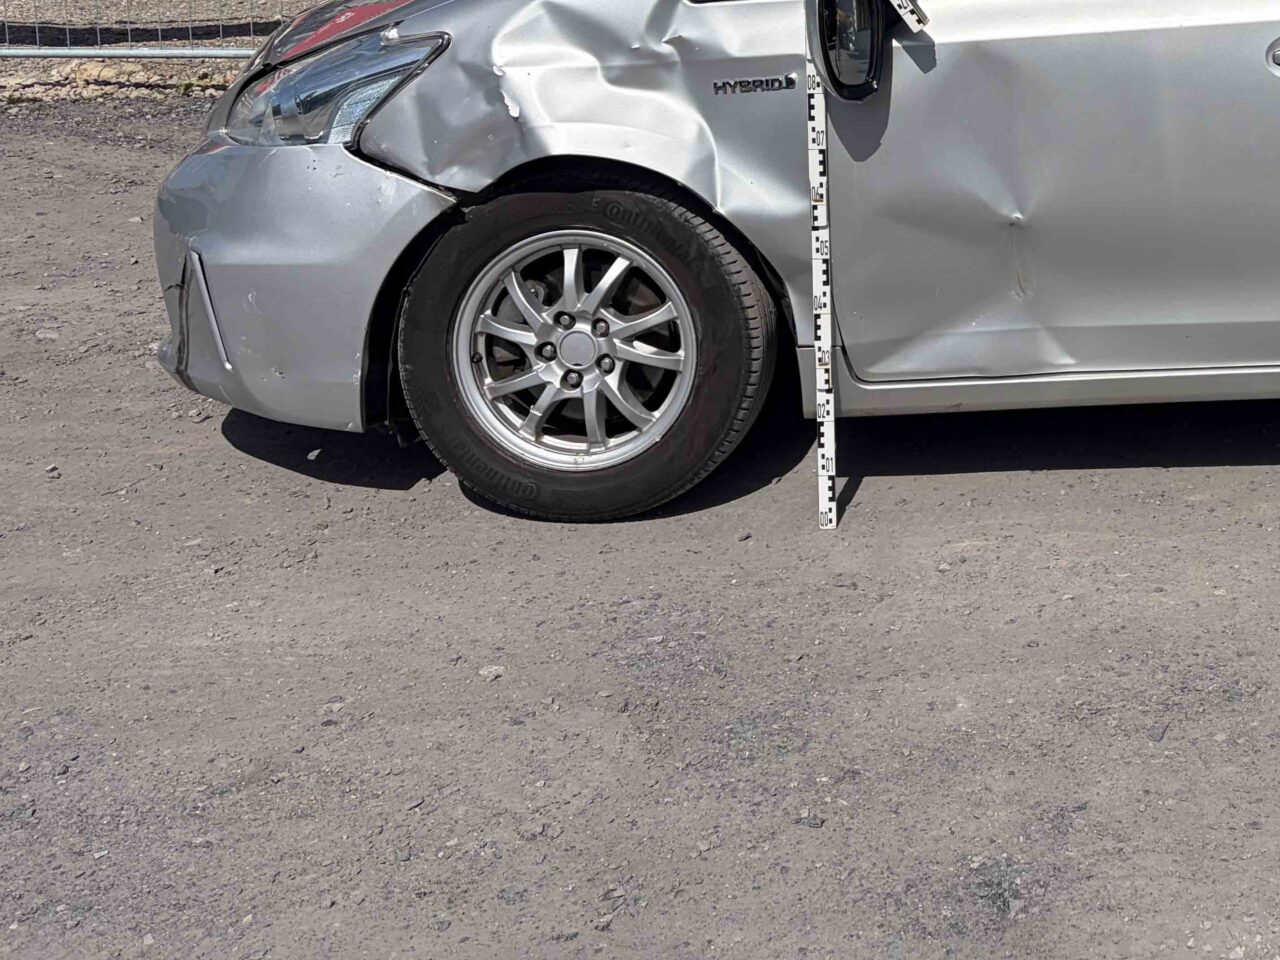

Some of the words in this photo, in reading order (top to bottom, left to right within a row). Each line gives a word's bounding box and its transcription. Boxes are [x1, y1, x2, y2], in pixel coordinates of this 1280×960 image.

[713, 78, 783, 95] HYBRID
[808, 75, 815, 90] 08
[816, 131, 825, 146] 07
[811, 187, 819, 201] 06
[820, 240, 828, 255] 05
[814, 296, 822, 310] 04
[821, 350, 830, 365] 03
[818, 403, 826, 418] 02
[825, 457, 834, 472] 01
